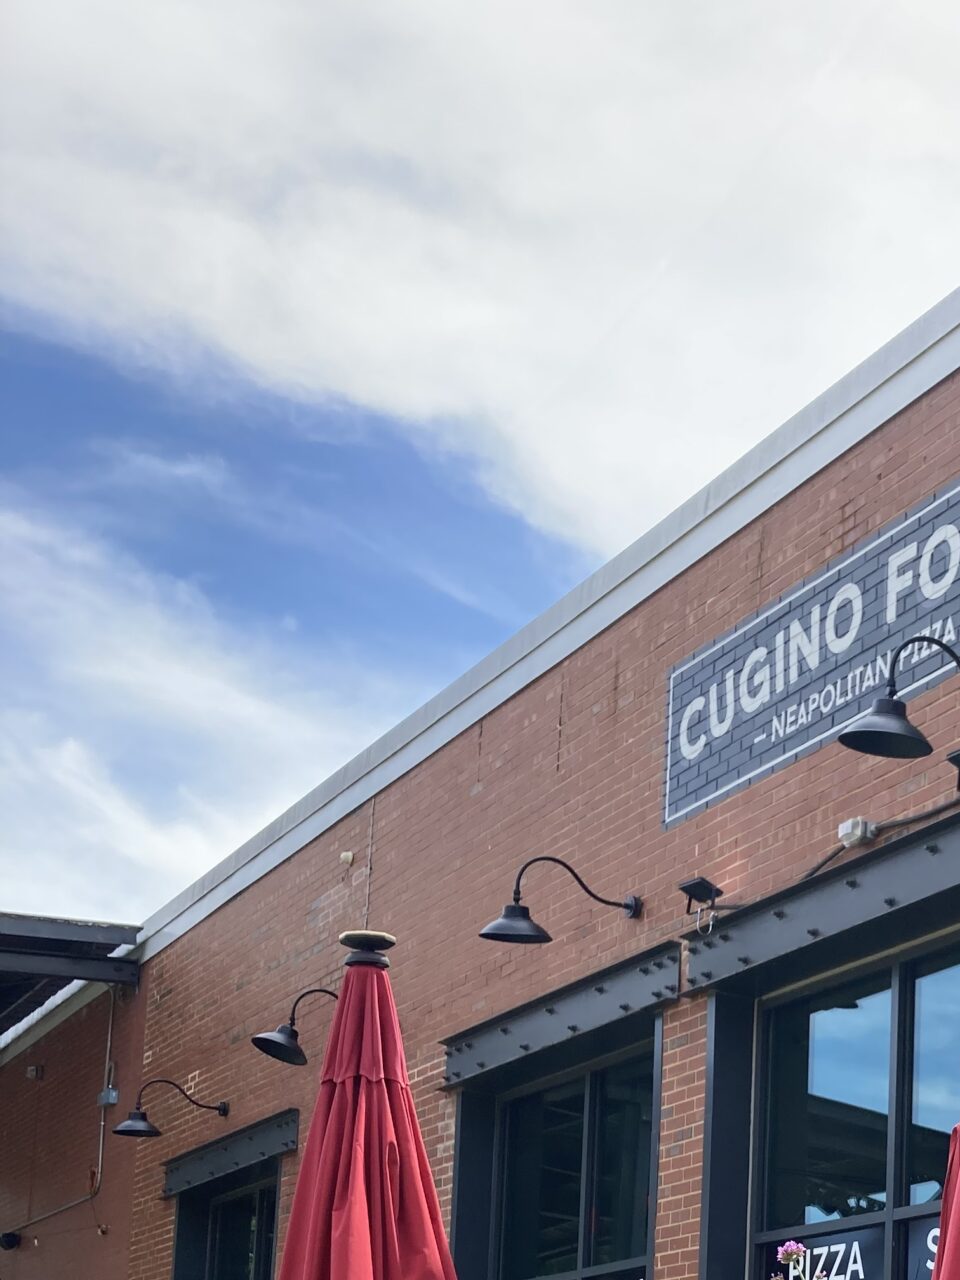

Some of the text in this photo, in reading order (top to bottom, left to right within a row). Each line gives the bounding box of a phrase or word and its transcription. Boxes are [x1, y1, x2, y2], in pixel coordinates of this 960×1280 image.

[679, 583, 863, 760] CUGINO
[771, 615, 956, 742] NEAPOLITAN PIZZA
